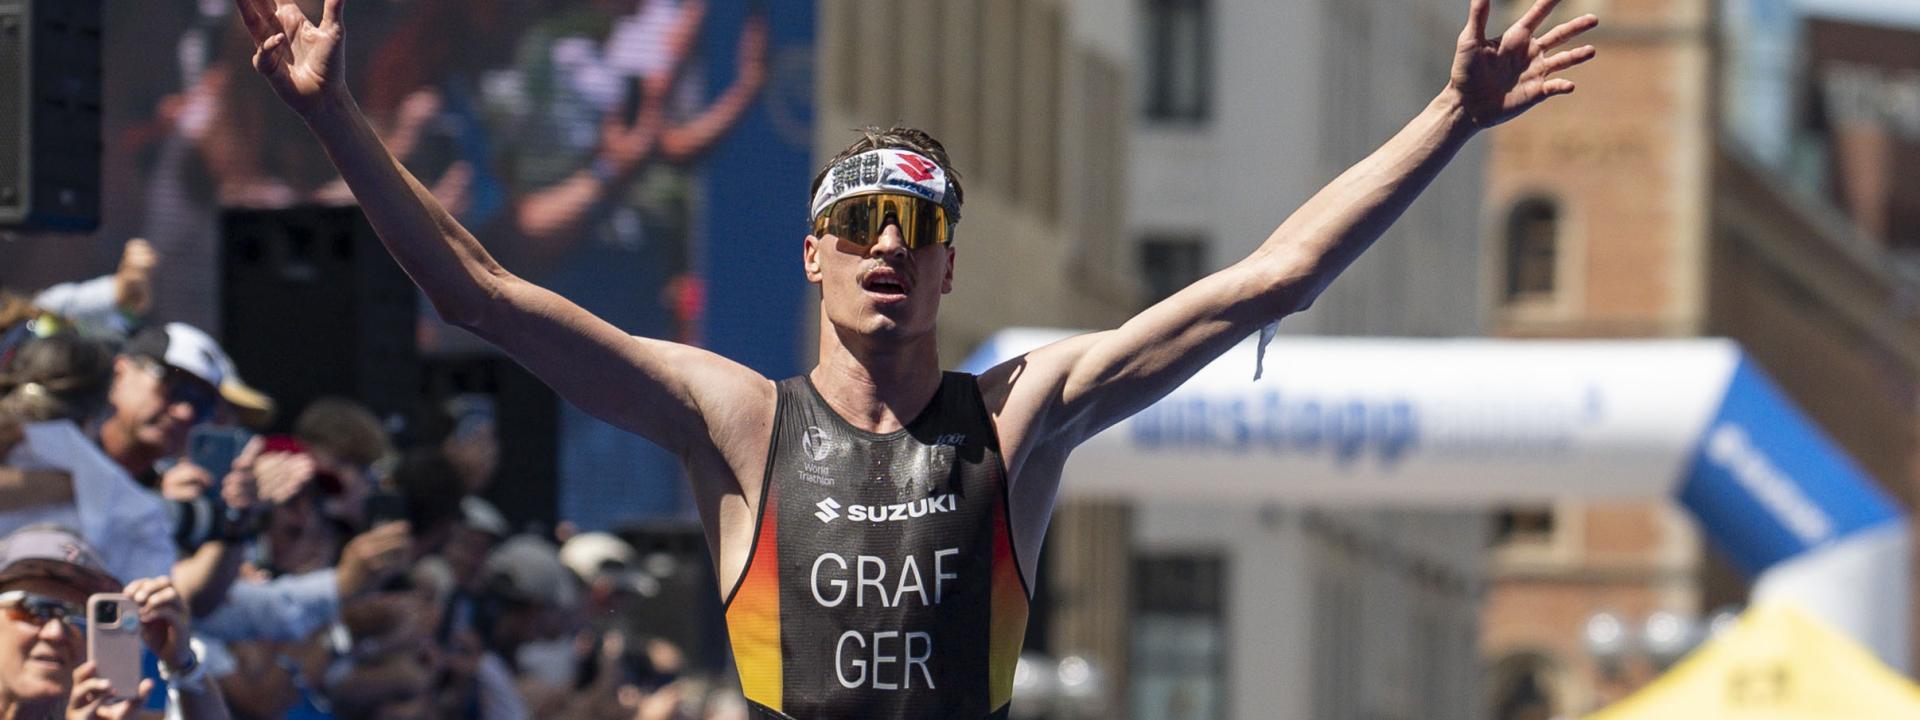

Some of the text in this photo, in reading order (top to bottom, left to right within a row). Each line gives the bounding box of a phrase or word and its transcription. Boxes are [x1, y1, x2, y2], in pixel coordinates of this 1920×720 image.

[797, 470, 835, 486] Triathlon
[803, 462, 829, 475] World
[847, 494, 956, 522] SUZUKI
[810, 548, 959, 607] GRAF
[835, 630, 935, 690] GER
